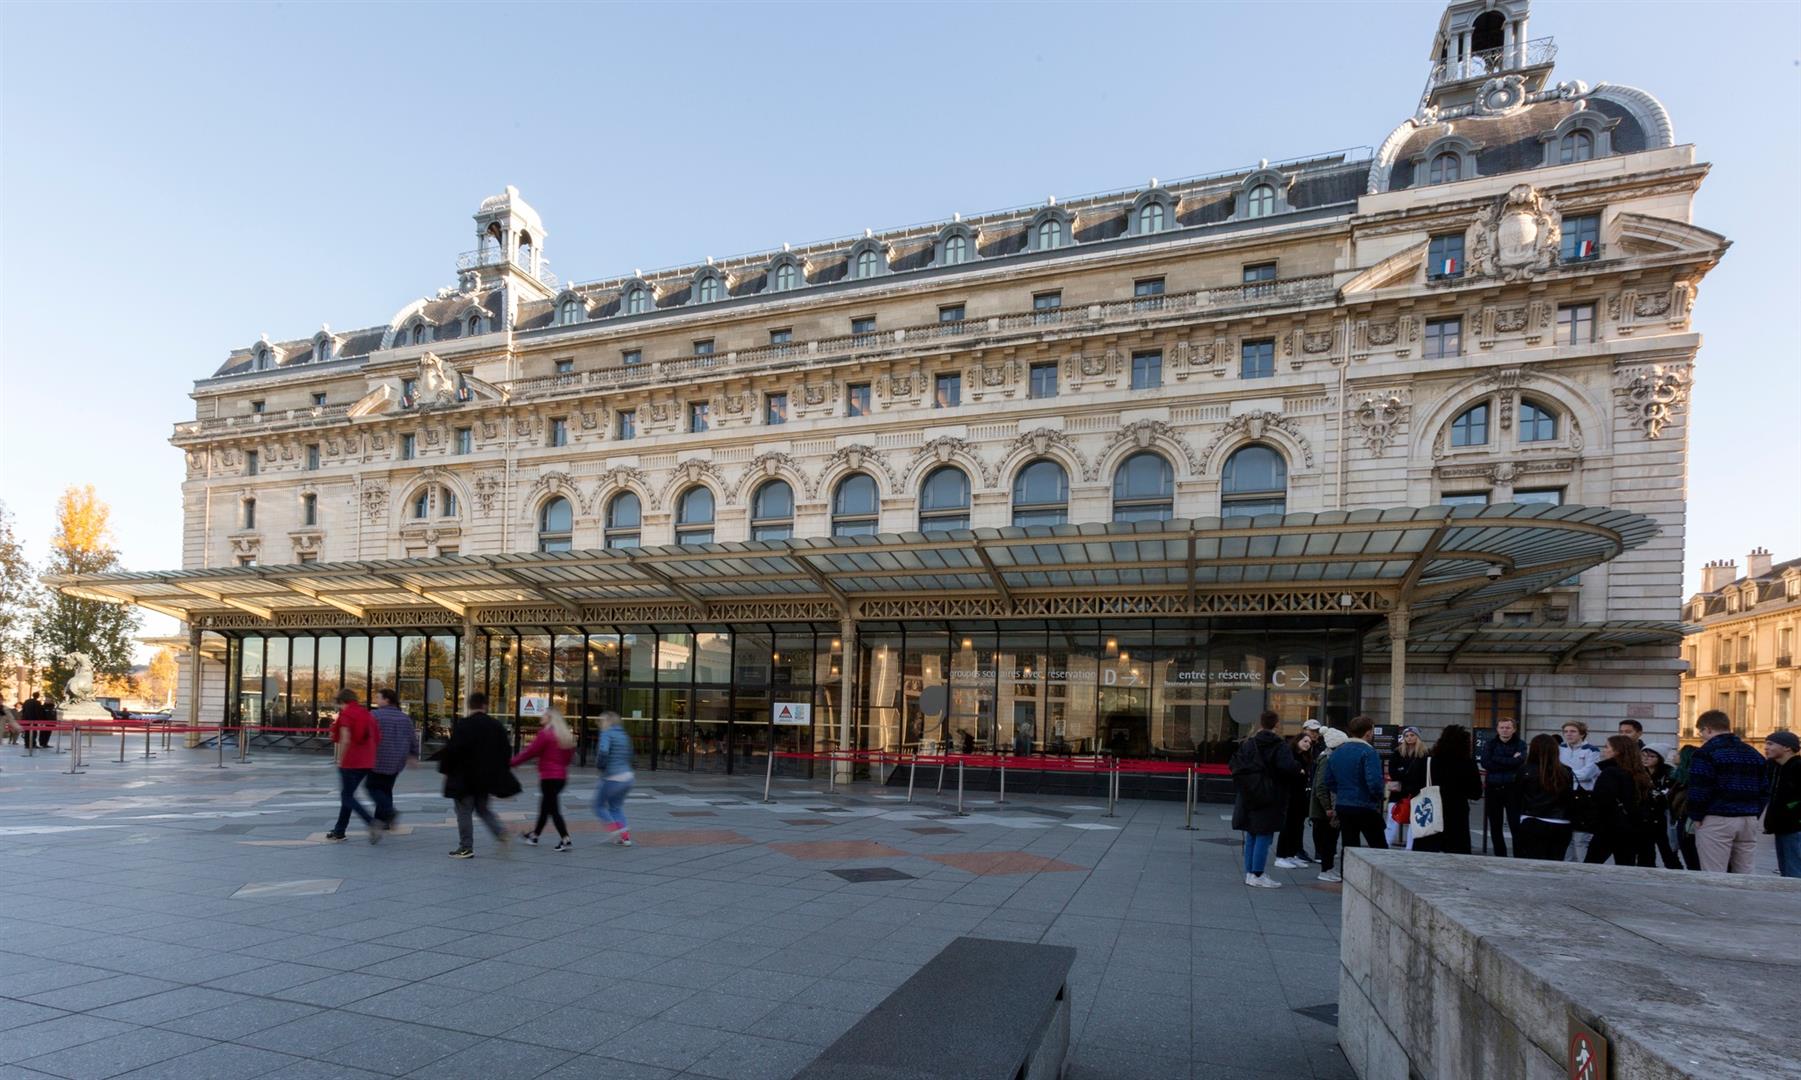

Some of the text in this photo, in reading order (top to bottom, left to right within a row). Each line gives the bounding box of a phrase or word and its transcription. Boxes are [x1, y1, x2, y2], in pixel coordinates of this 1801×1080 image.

[1103, 668, 1118, 686] D
[1178, 669, 1262, 680] entrée réservée
[1271, 669, 1287, 688] C
